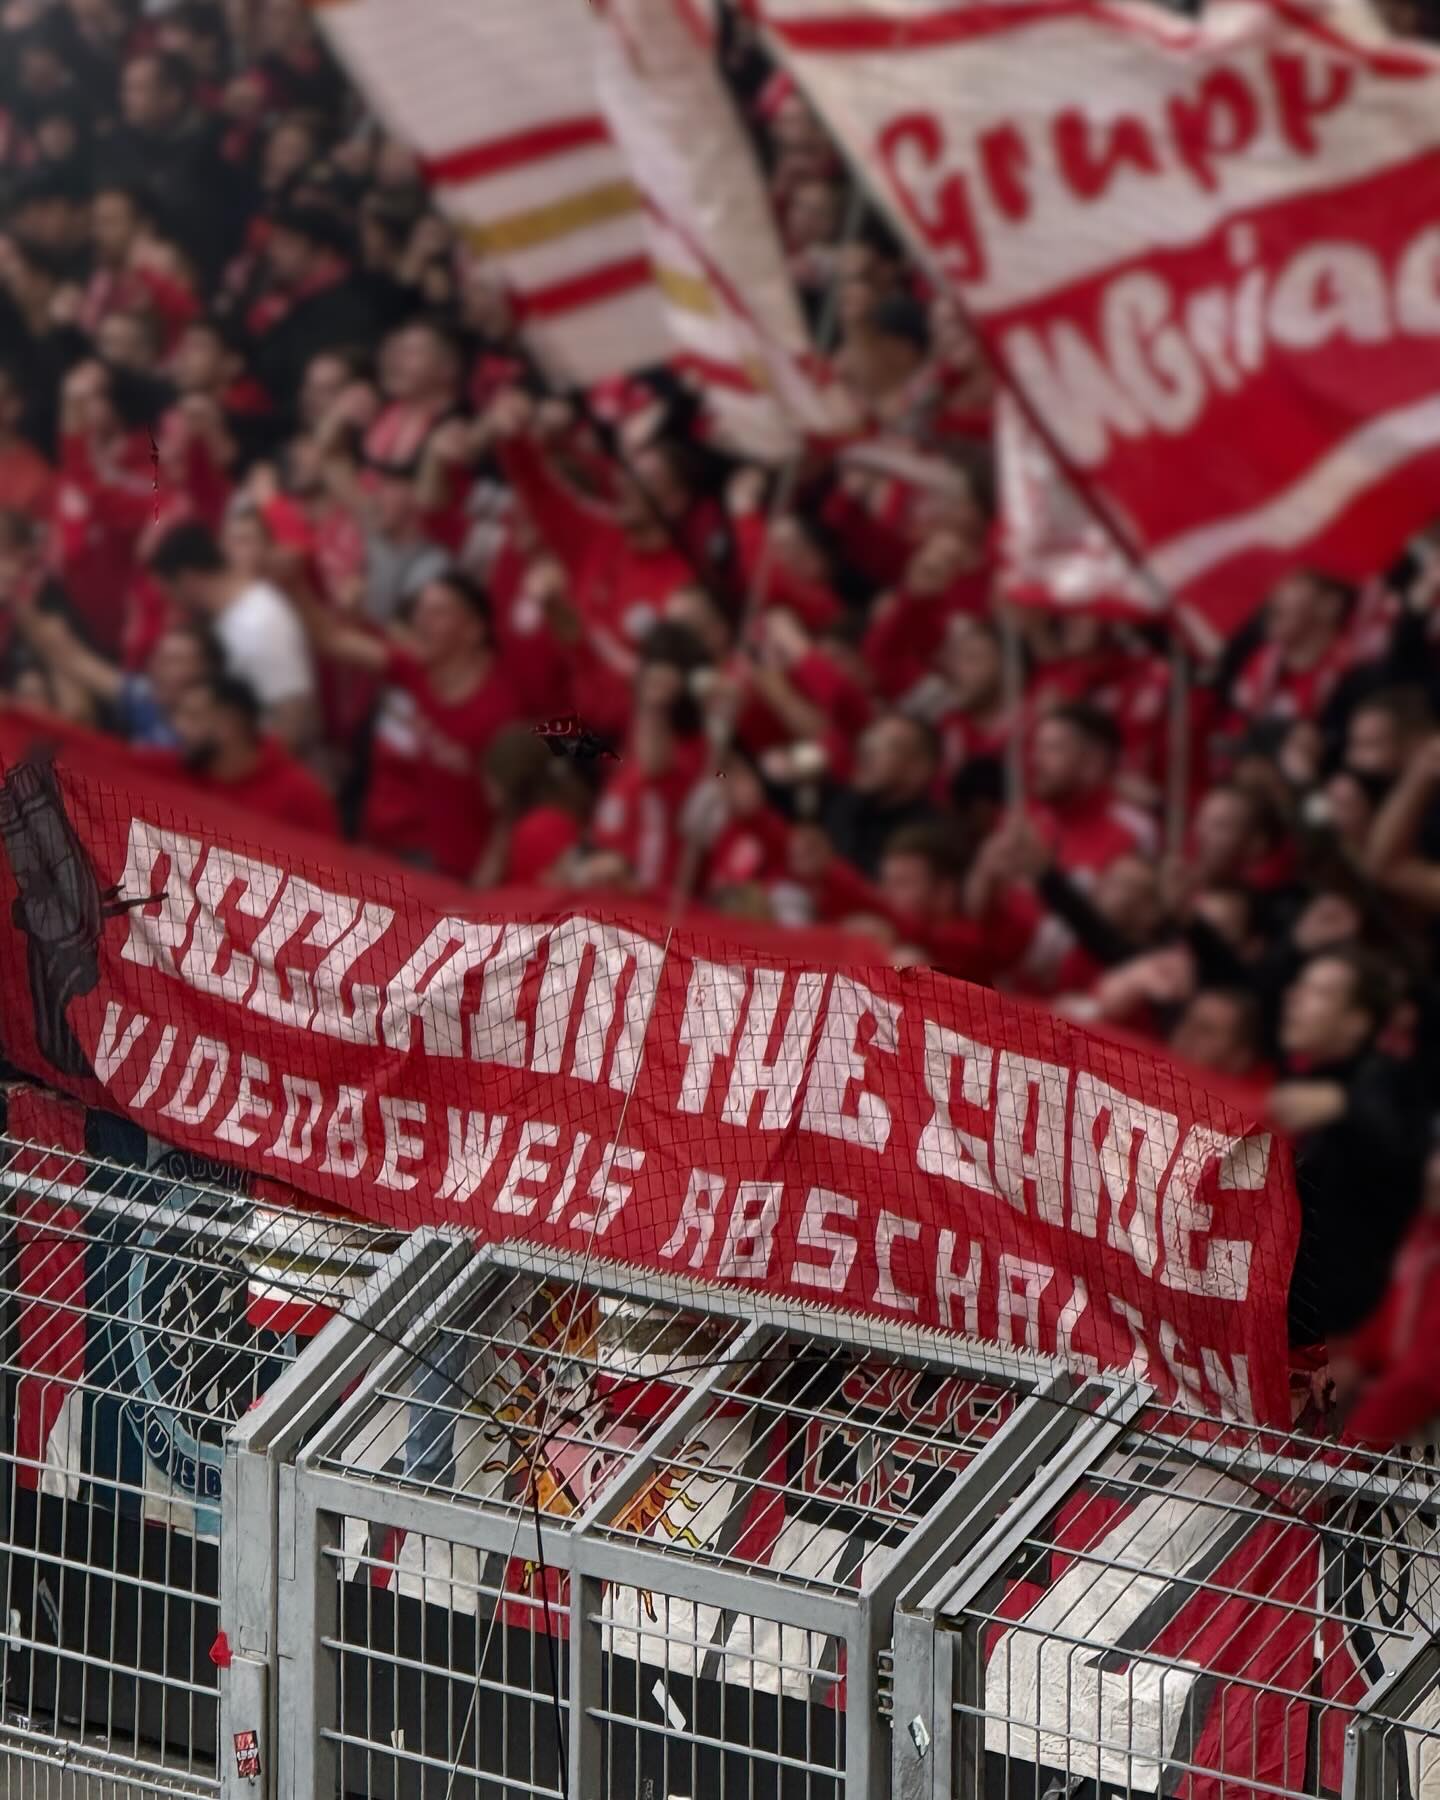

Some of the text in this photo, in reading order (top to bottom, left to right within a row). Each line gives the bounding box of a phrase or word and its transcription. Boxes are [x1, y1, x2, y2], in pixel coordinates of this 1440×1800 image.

[94, 1001, 645, 1236] VIDEOBEWEIS
[121, 817, 1272, 1301] RECLAIM THE GAME
